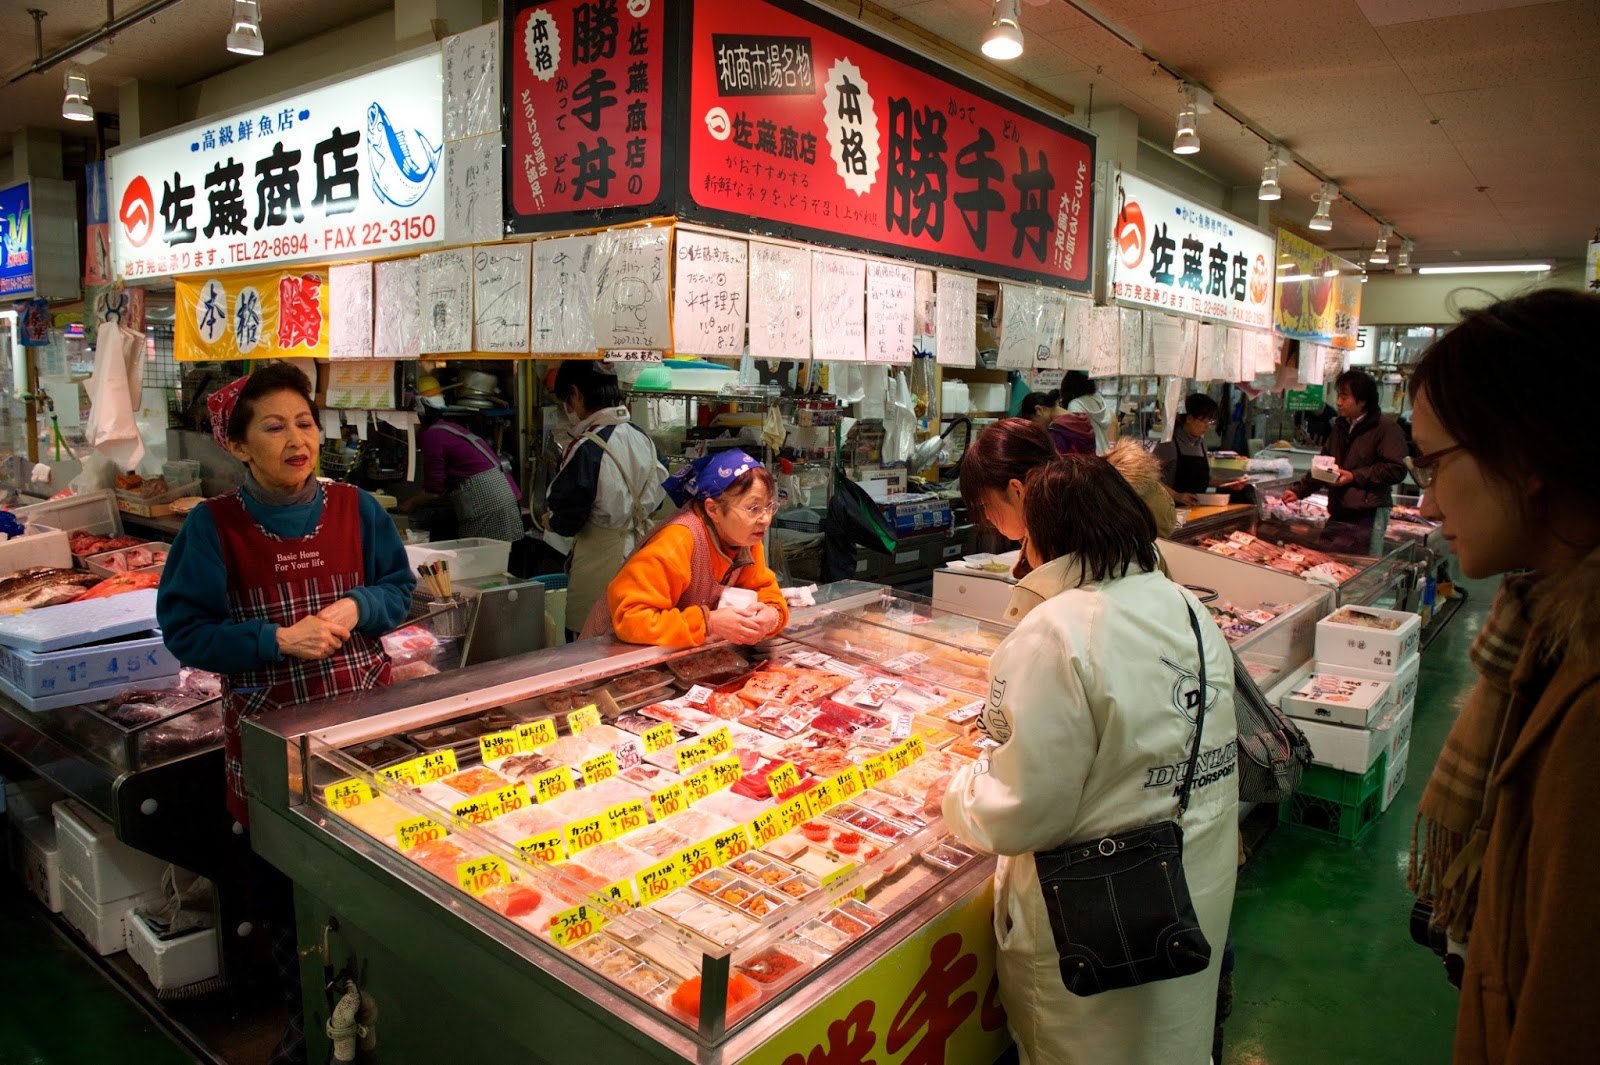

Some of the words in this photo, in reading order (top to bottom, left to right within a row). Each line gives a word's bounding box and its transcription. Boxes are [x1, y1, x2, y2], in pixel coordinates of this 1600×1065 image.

[532, 19, 553, 72] 本格
[718, 43, 812, 91] 和商市場名物
[556, 77, 569, 131] かって
[571, 0, 619, 201] 勝手丼
[625, 22, 648, 195] 佐藤商店の
[202, 109, 295, 151] 高級鮮魚店
[836, 75, 868, 176] 本格
[948, 98, 975, 124] かって
[1002, 119, 1020, 143] どん
[521, 89, 548, 177] とろける旨さ
[732, 111, 817, 166] 佐藤商店
[553, 153, 569, 194] どん
[725, 155, 809, 188] がおすすめする
[886, 96, 1056, 264] 勝手丼
[160, 126, 361, 247] 佐藤商店
[1064, 161, 1087, 271] とろける旨さ
[125, 247, 226, 276] 地方発送承ります。
[324, 226, 356, 250] FAX
[362, 214, 436, 246] 22-3150
[1150, 222, 1249, 302] 佐藤商店
[200, 283, 260, 348] 本格
[274, 563, 289, 572] For
[291, 561, 309, 570] Your
[311, 559, 325, 567] life
[276, 552, 297, 562] Basic
[299, 551, 320, 559] Home
[531, 732, 550, 746] 150
[655, 736, 673, 750] 500
[712, 740, 728, 756] 300
[493, 744, 514, 757] 300
[429, 764, 453, 780] 200
[593, 767, 612, 783] 150
[720, 770, 739, 786] 200
[1172, 762, 1236, 797] MTORSPORT
[334, 783, 360, 799] たまご
[548, 782, 567, 798] 150
[695, 784, 709, 799] 50
[780, 777, 795, 793] 100
[840, 780, 856, 798] 100
[342, 793, 361, 809] 50
[501, 798, 522, 815] 150
[662, 798, 679, 815] 100
[781, 801, 801, 817] いくら
[817, 796, 832, 812] 150
[467, 808, 492, 825] 250
[620, 814, 640, 831] 150
[789, 809, 806, 828] 200
[412, 828, 439, 846] 200
[577, 829, 603, 849] 100
[759, 824, 776, 843] 100
[682, 846, 709, 864] 生ウニ
[725, 839, 748, 861] 300
[467, 861, 499, 876] サーモン
[689, 856, 712, 877] 300
[649, 878, 669, 899] 150
[565, 921, 592, 943] 200
